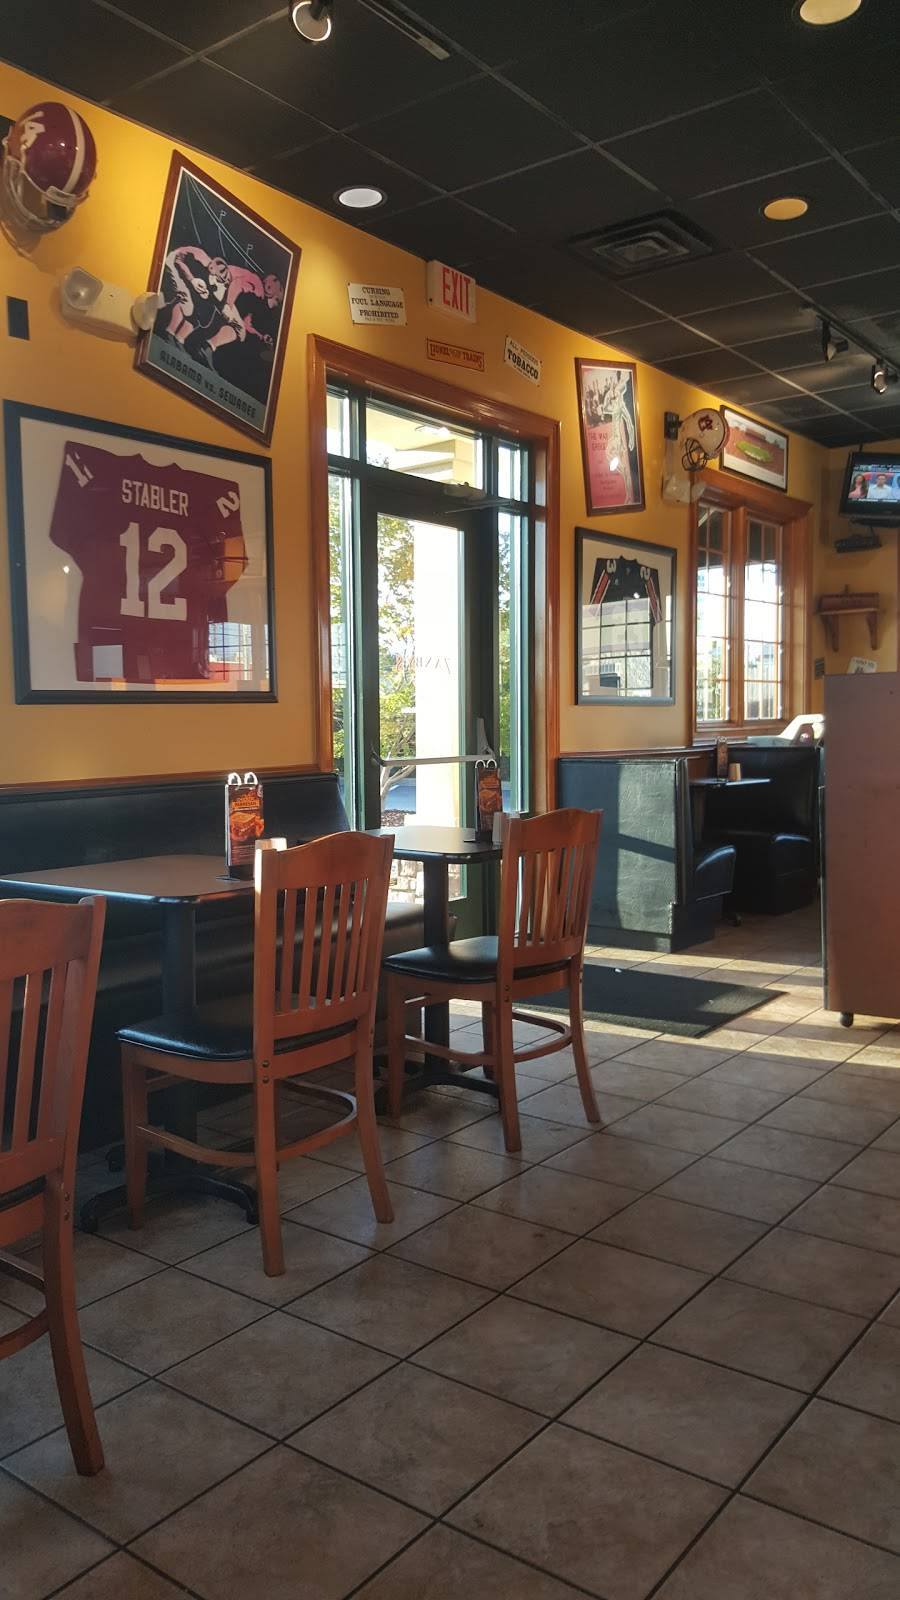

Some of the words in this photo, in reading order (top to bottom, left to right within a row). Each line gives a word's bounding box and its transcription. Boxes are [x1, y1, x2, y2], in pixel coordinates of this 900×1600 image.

[351, 297, 368, 306] FOUL
[370, 299, 404, 309] LANGUAGE
[442, 266, 471, 315] EXIT
[359, 309, 400, 319] PROHIBITED
[507, 349, 539, 380] TOBACCO
[160, 350, 203, 385] ALABAMA
[218, 387, 258, 419] SEWANEE
[121, 479, 189, 517] STABLER
[119, 521, 188, 622] 12
